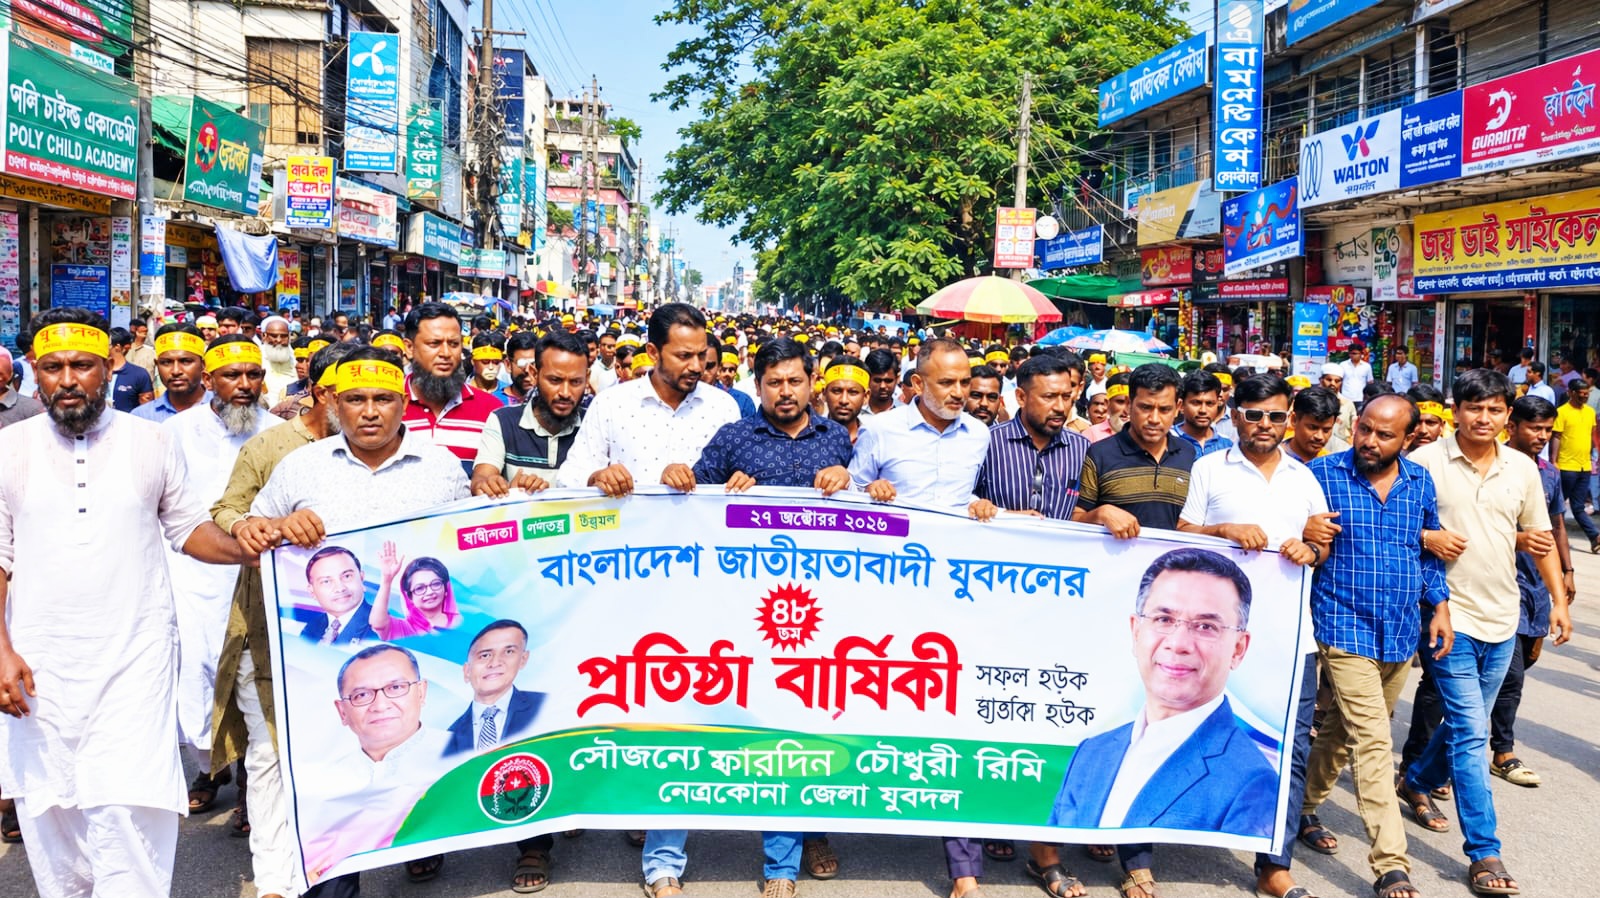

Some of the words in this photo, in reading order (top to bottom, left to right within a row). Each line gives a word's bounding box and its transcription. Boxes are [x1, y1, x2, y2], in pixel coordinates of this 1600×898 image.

[9, 122, 45, 151] POLY
[47, 133, 84, 163] CHILD
[84, 145, 136, 176] ACADEMY
[1333, 156, 1390, 185] WALTON
[1420, 227, 1456, 264] জয়
[750, 510, 772, 526] ২৭
[844, 513, 888, 532] ২০২৬
[538, 542, 704, 587] বাংলাদেশ
[715, 534, 936, 588] জাতীয়তাবাদী
[947, 557, 1090, 602] যুবদলের
[771, 598, 812, 625] ৪৮
[776, 627, 803, 642] তম
[577, 632, 754, 718] প্রতিষ্ঠা
[771, 632, 963, 718] বার্ষিকী
[569, 737, 705, 771] সৌজন্যে
[856, 741, 962, 783] চৌধুরী
[973, 747, 1047, 782] রিমি
[658, 781, 790, 805] নেত্রকোনা
[800, 783, 870, 807] জেলা
[880, 785, 963, 814] যুবদল
